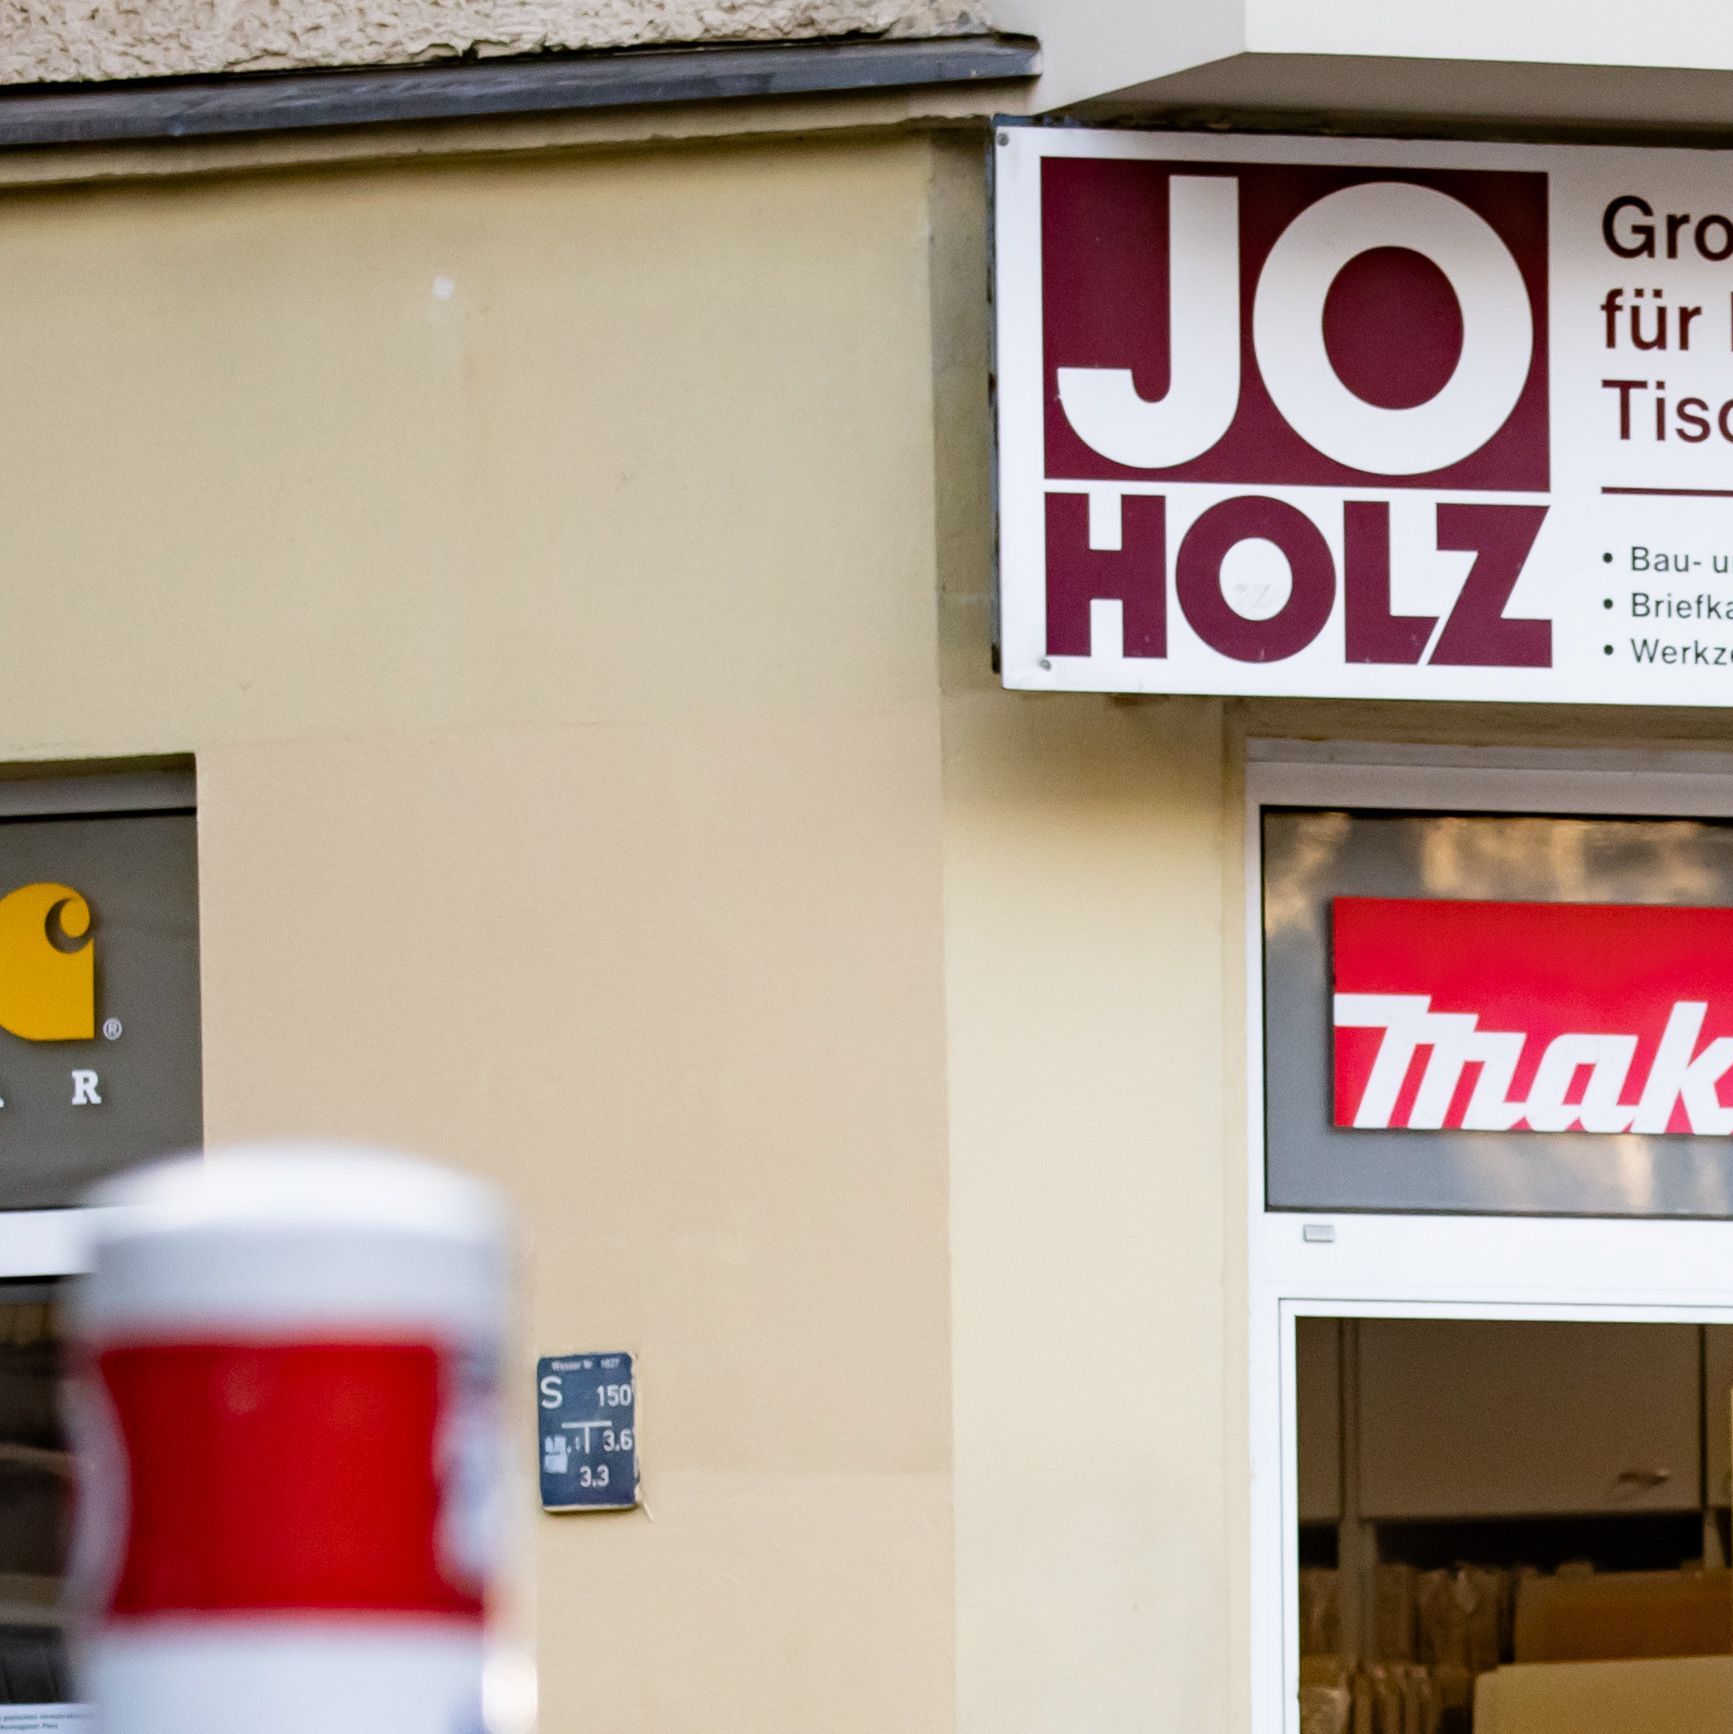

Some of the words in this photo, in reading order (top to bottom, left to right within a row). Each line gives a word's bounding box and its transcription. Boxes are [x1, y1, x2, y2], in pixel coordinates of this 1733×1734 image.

[1056, 174, 1534, 475] JO
[1601, 287, 1702, 352] für
[1044, 491, 1553, 668] HOLZ
[1630, 545, 1702, 574] Bau-
[540, 1374, 563, 1410] S
[596, 1383, 632, 1408] 150
